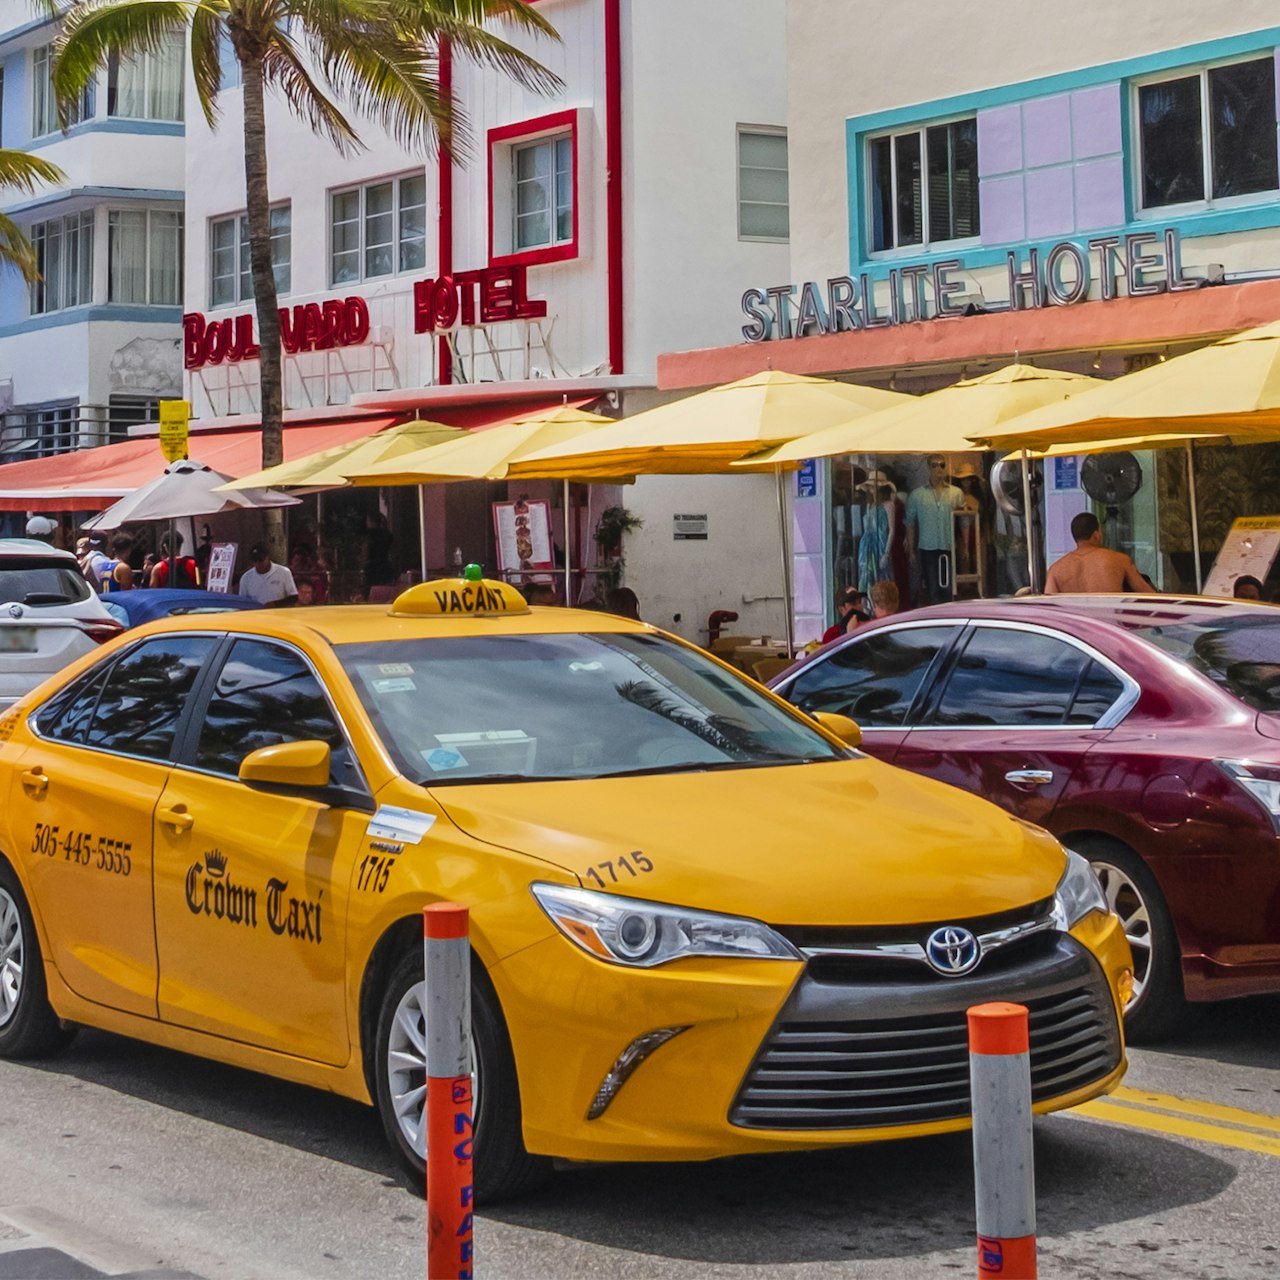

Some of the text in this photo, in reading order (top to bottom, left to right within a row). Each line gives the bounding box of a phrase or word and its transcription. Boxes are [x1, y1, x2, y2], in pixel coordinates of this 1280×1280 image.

[741, 228, 1203, 343] STARLITE HOTEL
[183, 266, 547, 370] BOULVARD HOTEL
[434, 586, 507, 613] VACANT
[31, 822, 132, 877] 305-445-5555
[357, 854, 396, 893] 1715
[586, 850, 654, 889] 1715
[185, 861, 323, 945] Crown Taxi
